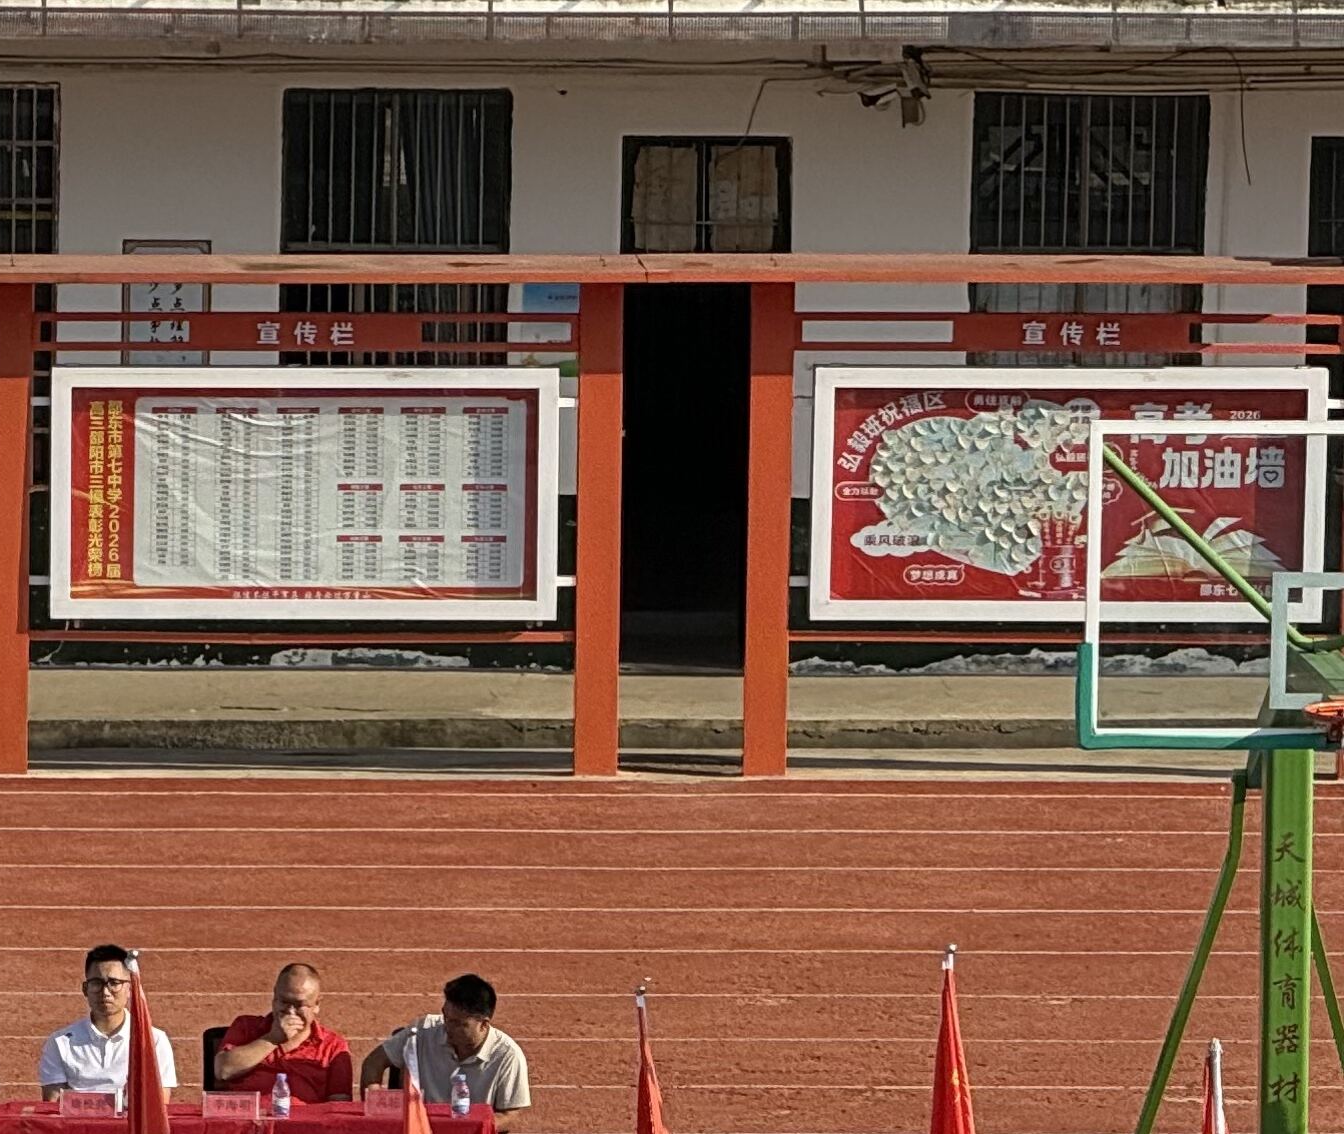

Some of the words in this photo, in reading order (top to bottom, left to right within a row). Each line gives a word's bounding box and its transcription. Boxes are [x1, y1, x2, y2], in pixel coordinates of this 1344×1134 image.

[255, 321, 356, 345] 宣传栏
[1021, 321, 1122, 345] 宣传栏
[1229, 410, 1261, 420] 2026
[1159, 446, 1286, 489] 加油墙
[1270, 831, 1307, 1104] 天城体育器材
